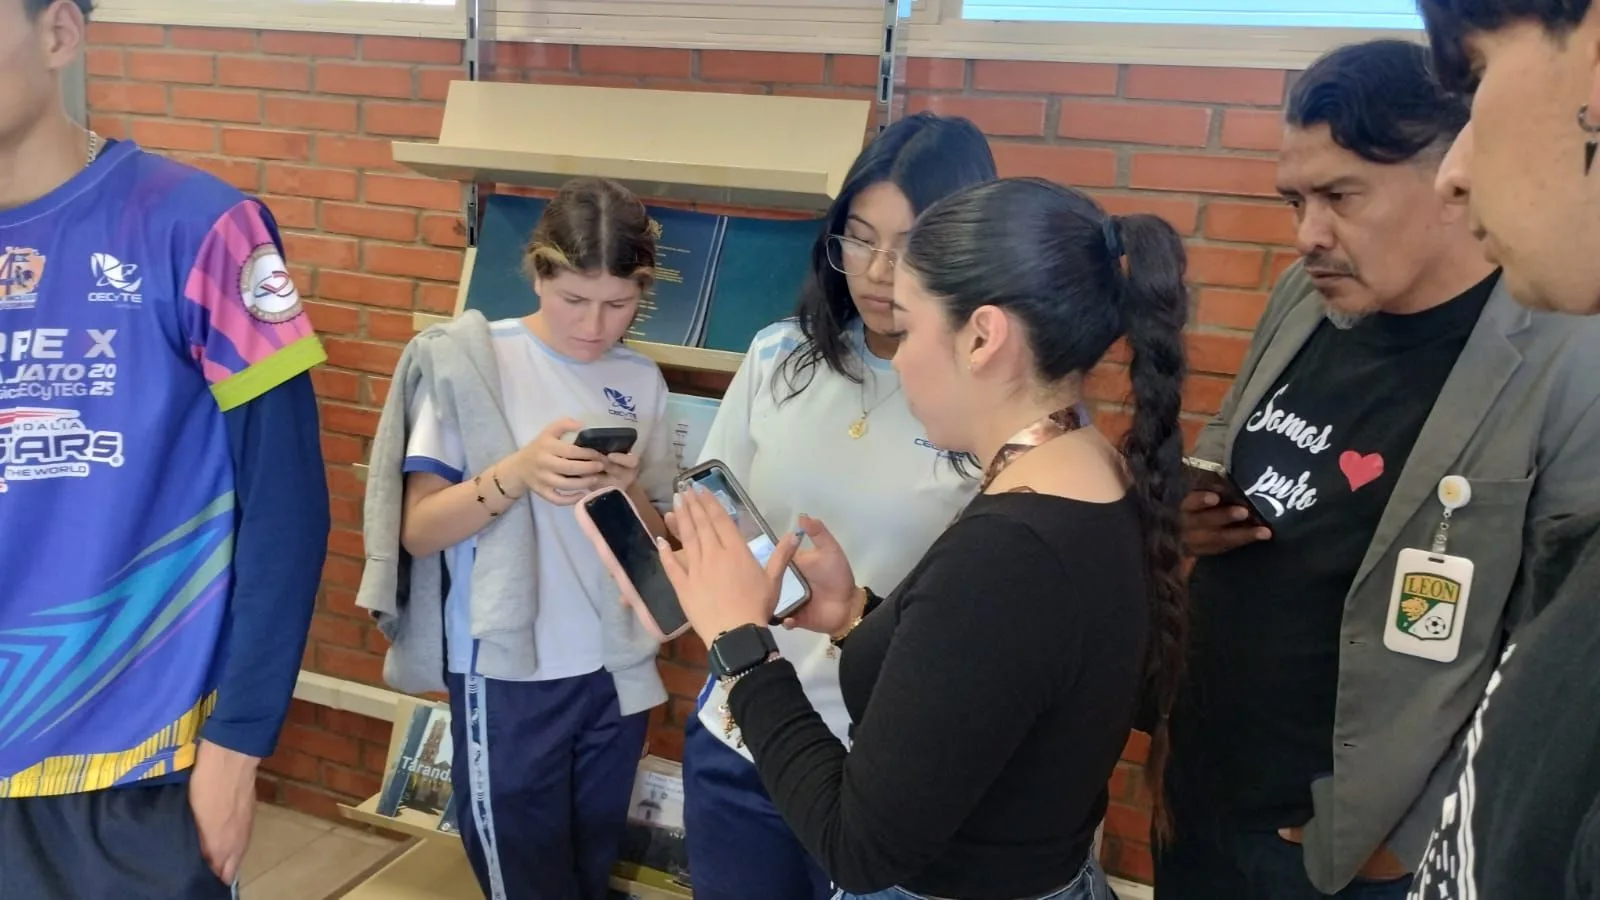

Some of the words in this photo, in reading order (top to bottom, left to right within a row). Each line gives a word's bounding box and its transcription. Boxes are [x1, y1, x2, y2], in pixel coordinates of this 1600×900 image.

[0, 328, 69, 362] PE
[83, 329, 118, 359] X
[0, 363, 86, 384] JATO
[88, 363, 117, 379] 20
[89, 381, 116, 396] 25
[1246, 383, 1333, 454] Somos
[0, 433, 118, 460] ARS
[33, 465, 87, 477] WORLD
[1244, 465, 1318, 517] puro
[1407, 577, 1455, 600] LEON
